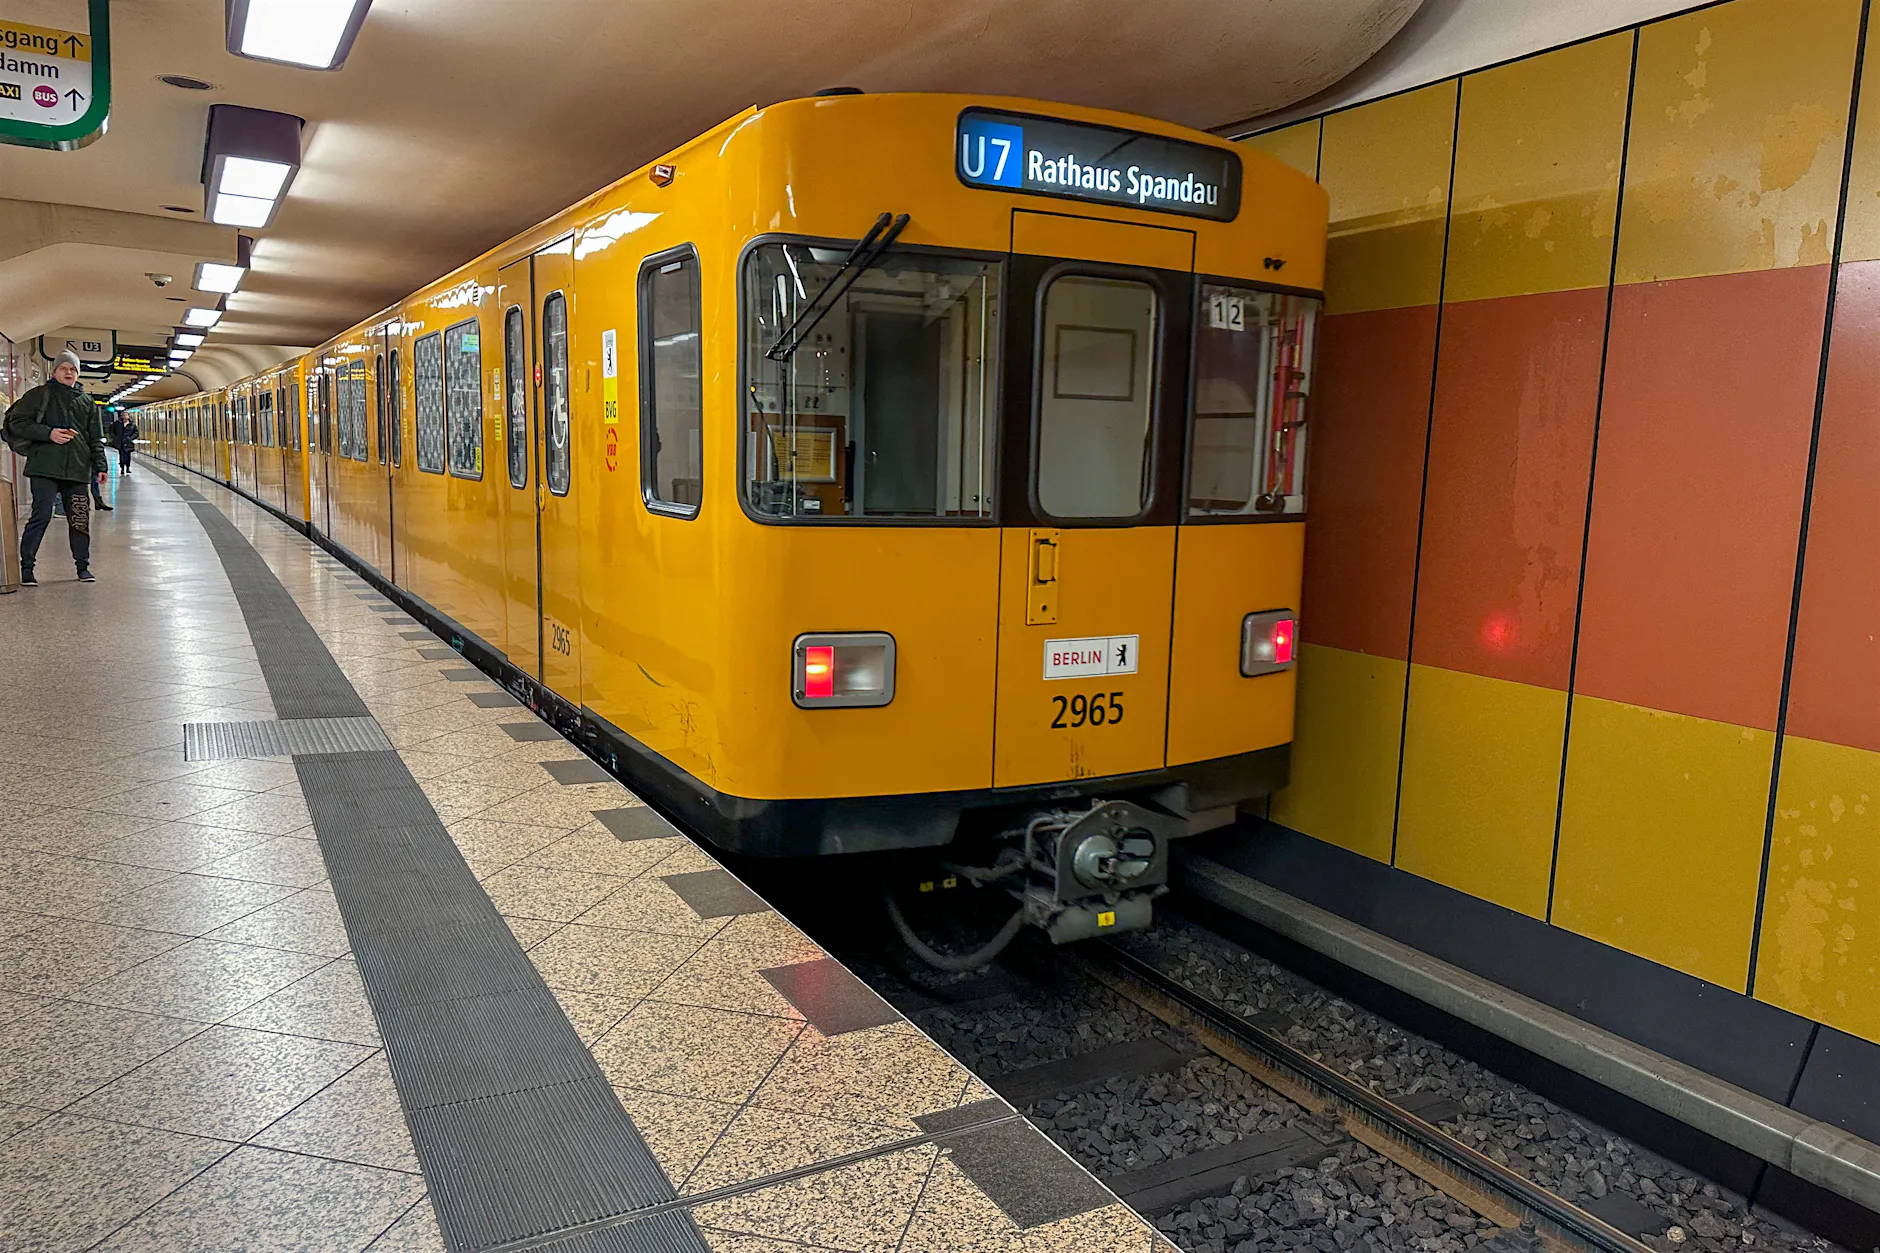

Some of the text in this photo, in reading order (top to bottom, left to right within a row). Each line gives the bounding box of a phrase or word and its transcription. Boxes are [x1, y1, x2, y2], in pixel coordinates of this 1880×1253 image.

[34, 91, 57, 103] BUS
[1028, 149, 1121, 194] Rathaus
[1126, 166, 1219, 206] Spandau
[1214, 301, 1241, 325] 12
[85, 342, 100, 351] U3
[605, 400, 617, 419] BVG
[552, 625, 570, 656] 2965
[1053, 650, 1102, 666] BERLIN
[1051, 691, 1124, 729] 2965
